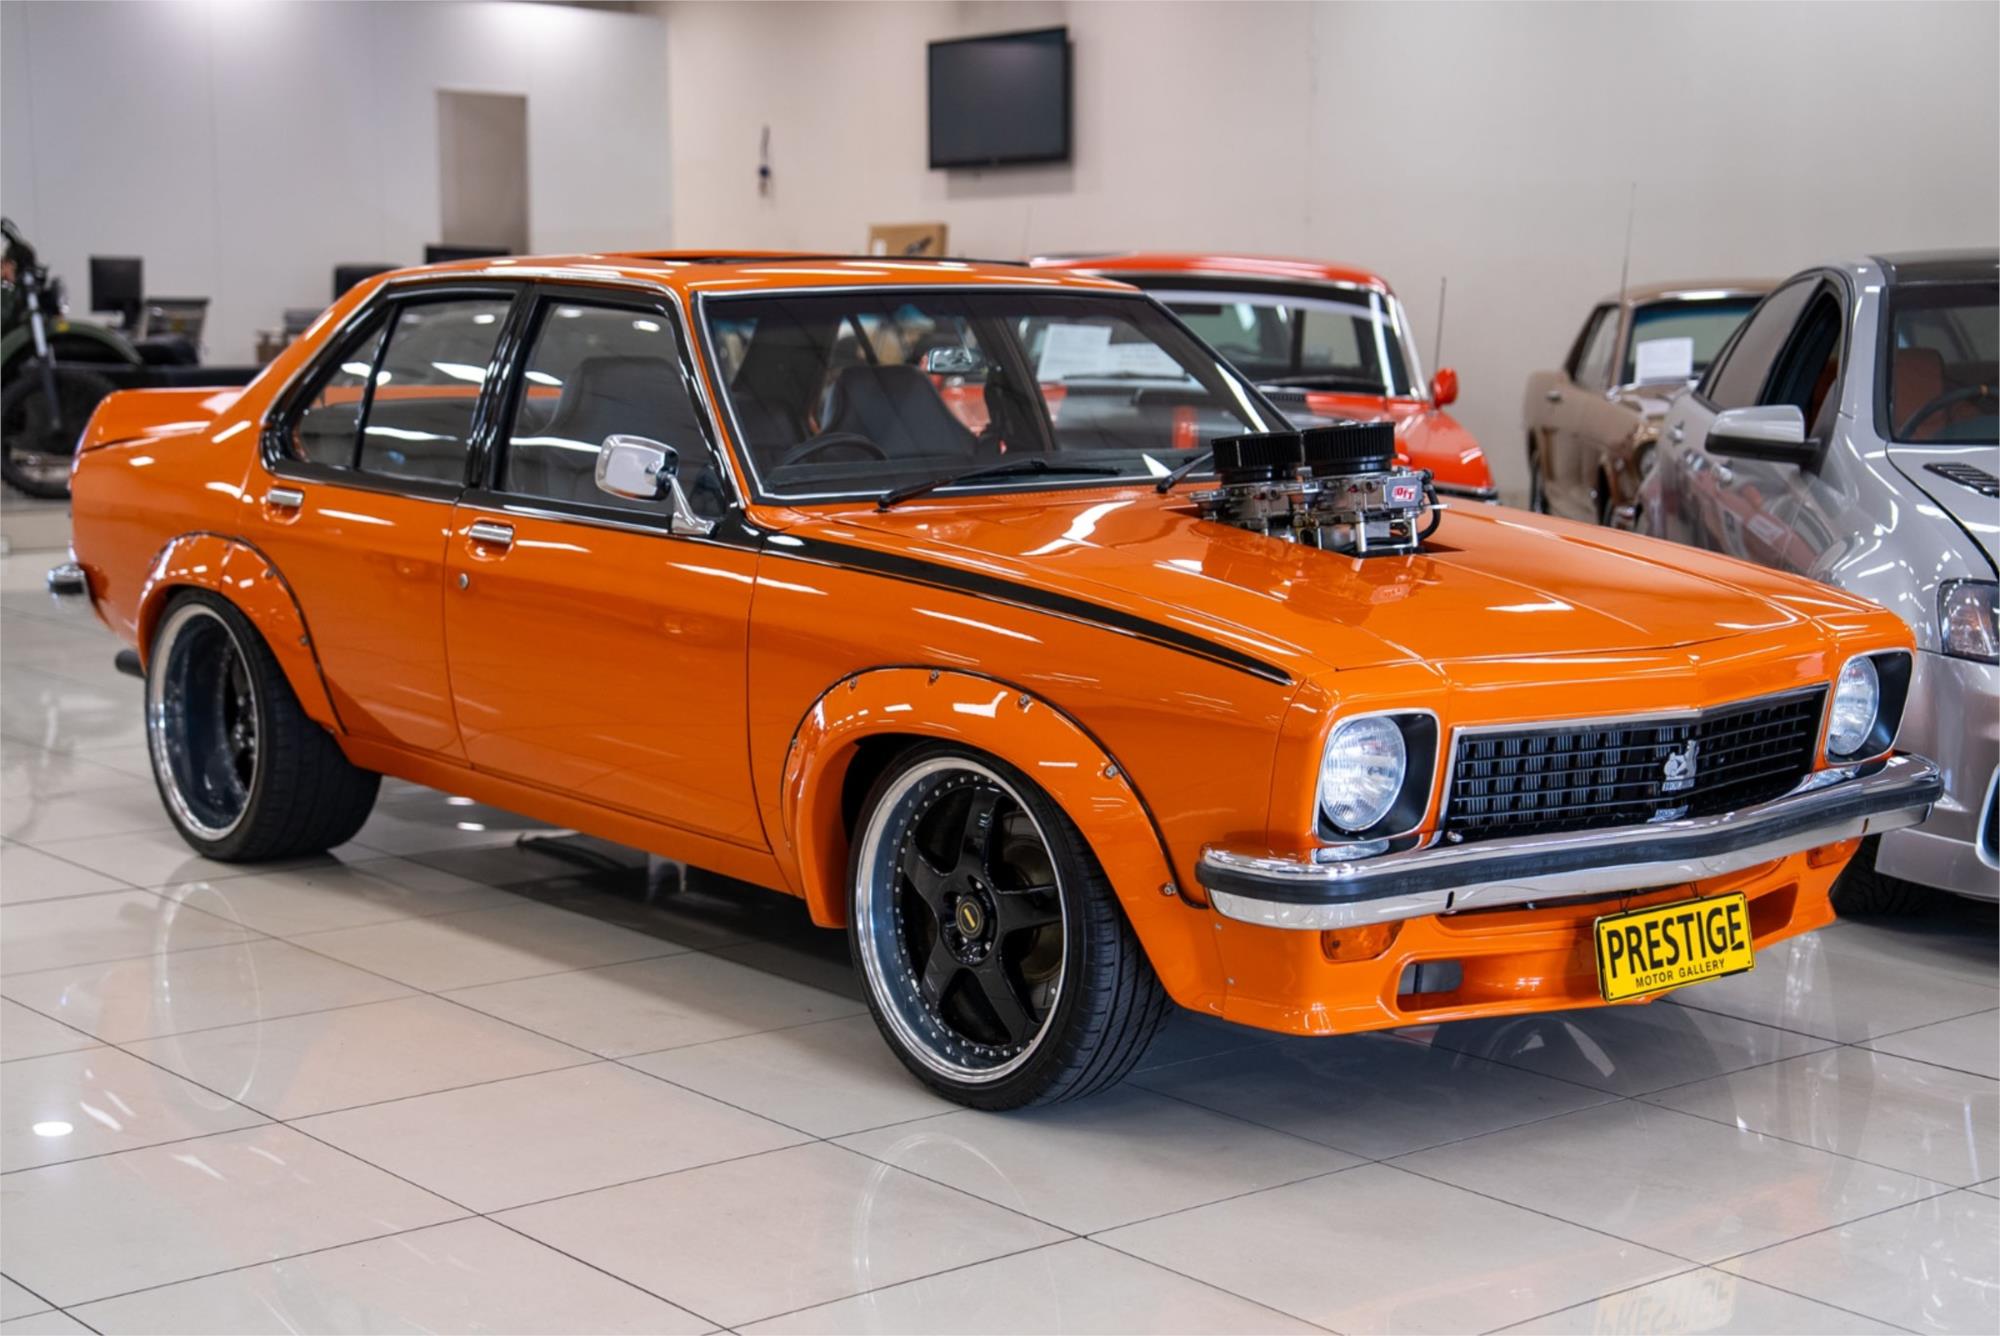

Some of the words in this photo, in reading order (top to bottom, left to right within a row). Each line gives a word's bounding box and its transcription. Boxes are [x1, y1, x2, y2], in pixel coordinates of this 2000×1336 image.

[1606, 903, 1745, 979] PRESTIGE
[1635, 968, 1674, 988] MOTOR
[1679, 958, 1725, 978] GALLERY
